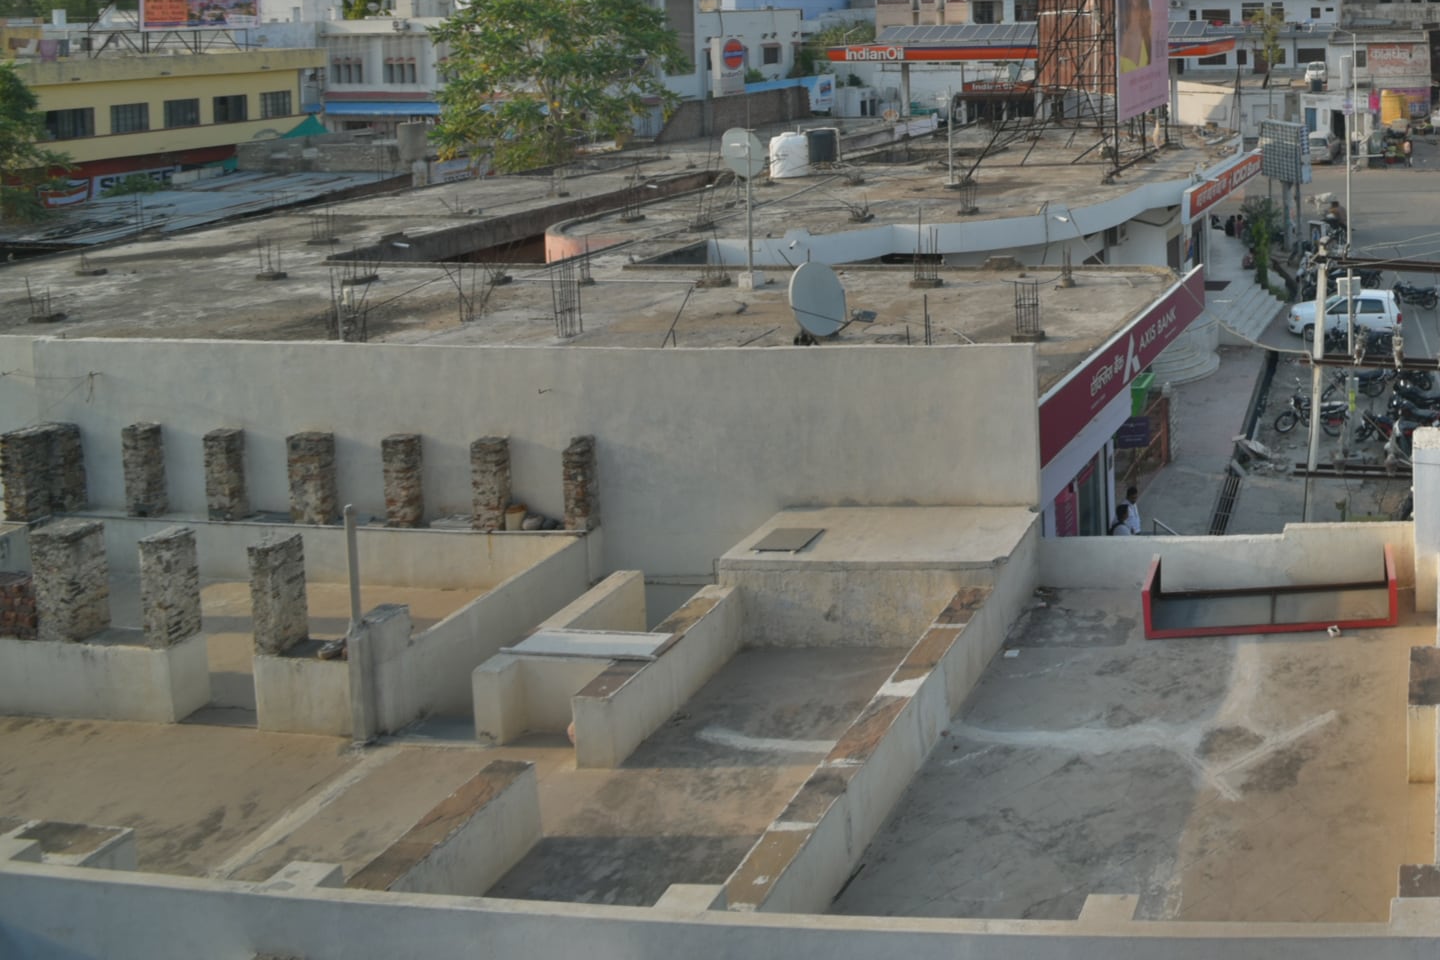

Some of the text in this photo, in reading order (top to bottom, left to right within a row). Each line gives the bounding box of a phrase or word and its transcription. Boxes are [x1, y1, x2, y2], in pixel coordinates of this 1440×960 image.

[845, 46, 904, 61] IndianOil
[1139, 304, 1177, 352] AXIS BANK
